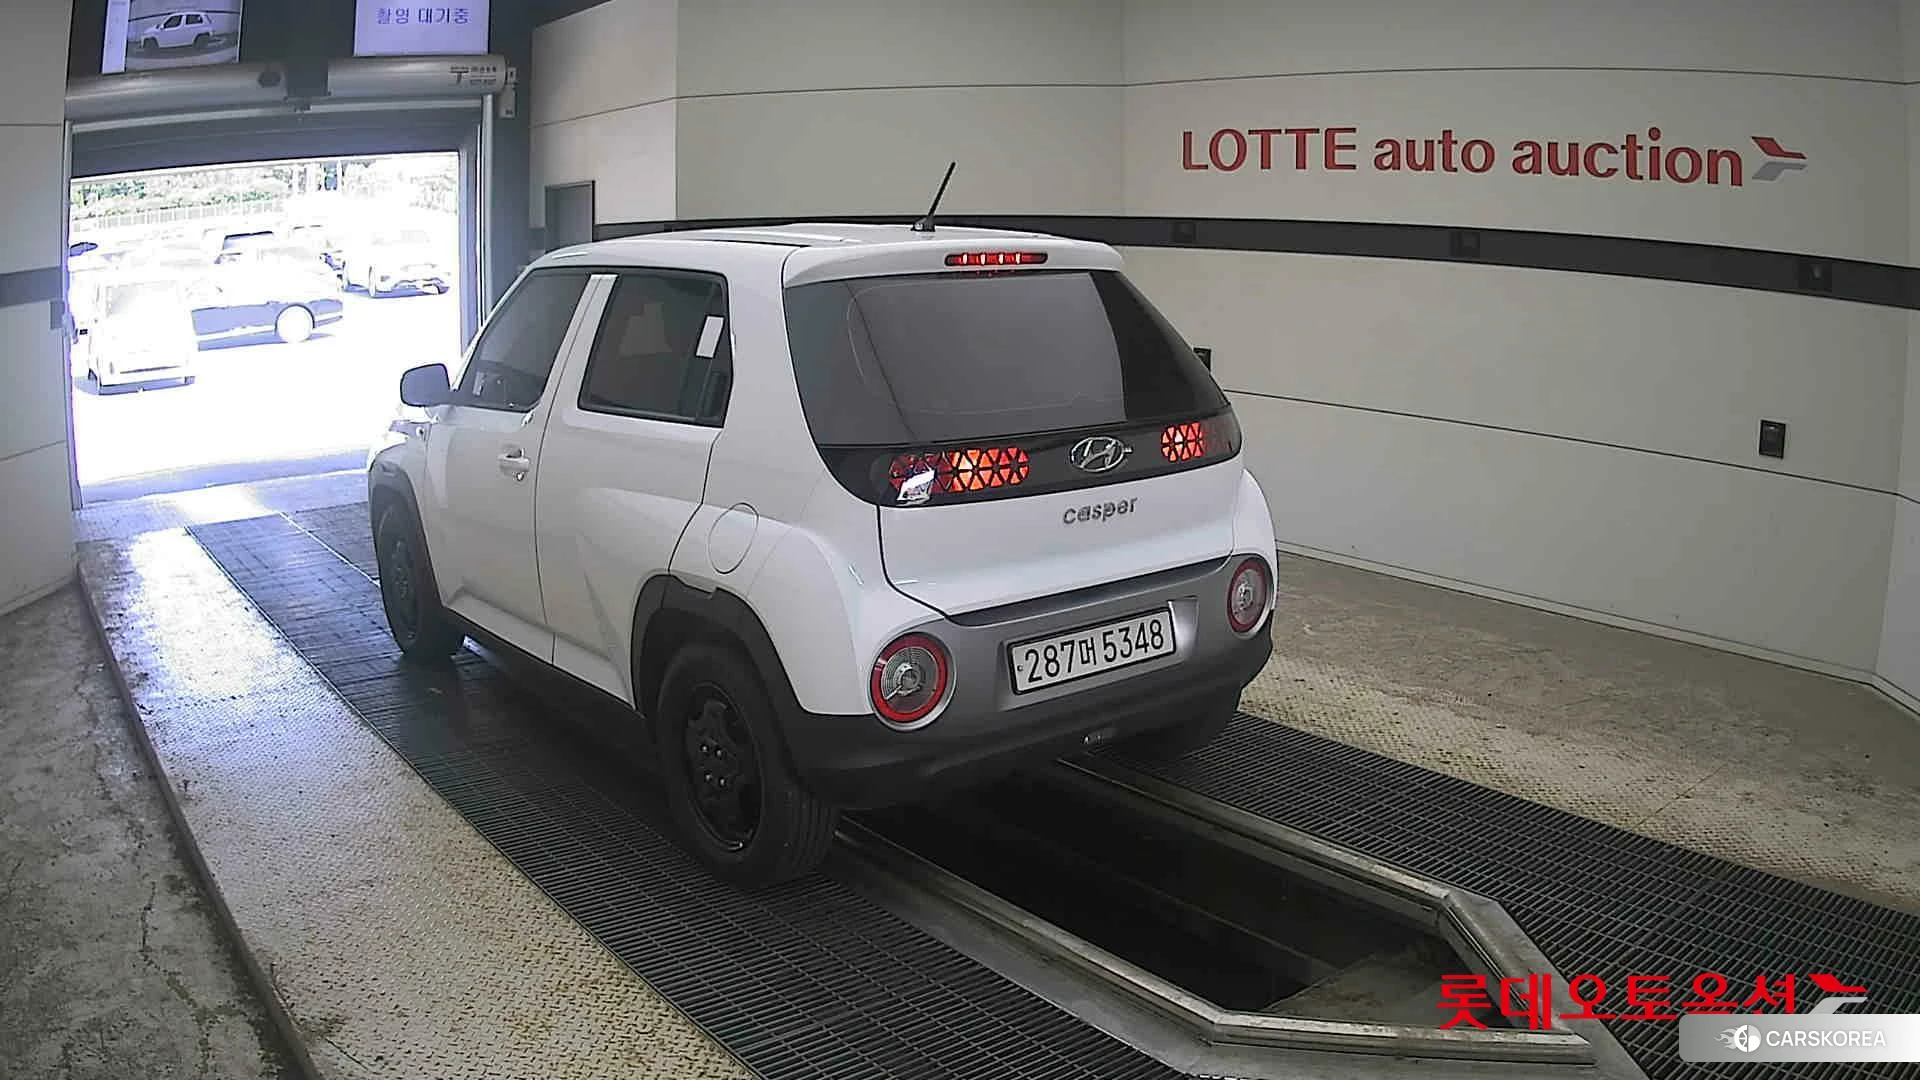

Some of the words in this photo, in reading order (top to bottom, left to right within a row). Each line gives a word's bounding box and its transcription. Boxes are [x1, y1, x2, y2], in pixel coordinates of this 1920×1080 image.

[418, 7, 470, 25] 대기중
[1182, 127, 1358, 173] LOTTE
[1373, 128, 1496, 175] auto
[1511, 126, 1743, 187] auction
[1024, 636, 1097, 683] 287머
[1102, 619, 1164, 662] 5348
